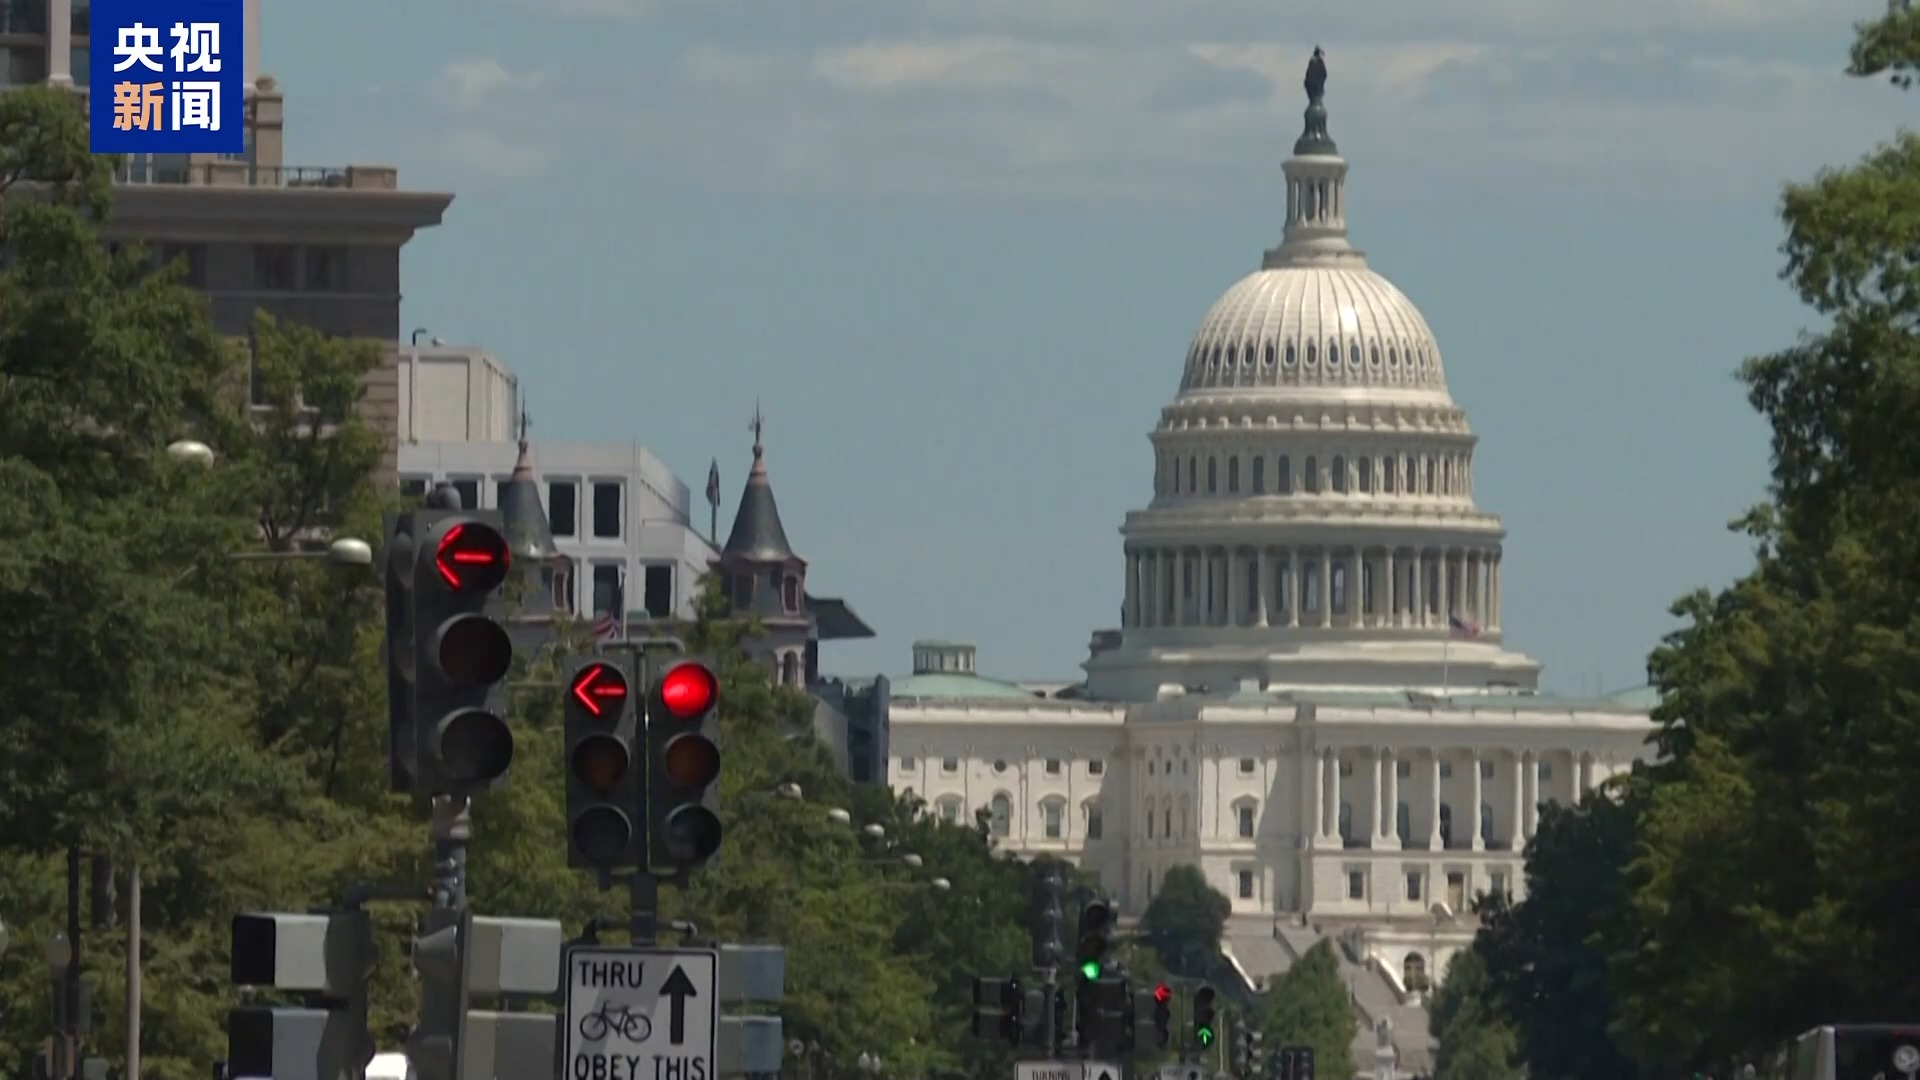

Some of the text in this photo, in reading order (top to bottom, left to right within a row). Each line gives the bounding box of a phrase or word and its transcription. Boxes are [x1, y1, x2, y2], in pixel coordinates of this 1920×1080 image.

[579, 960, 644, 988] THRU
[574, 1053, 706, 1080] OBEY THIS
